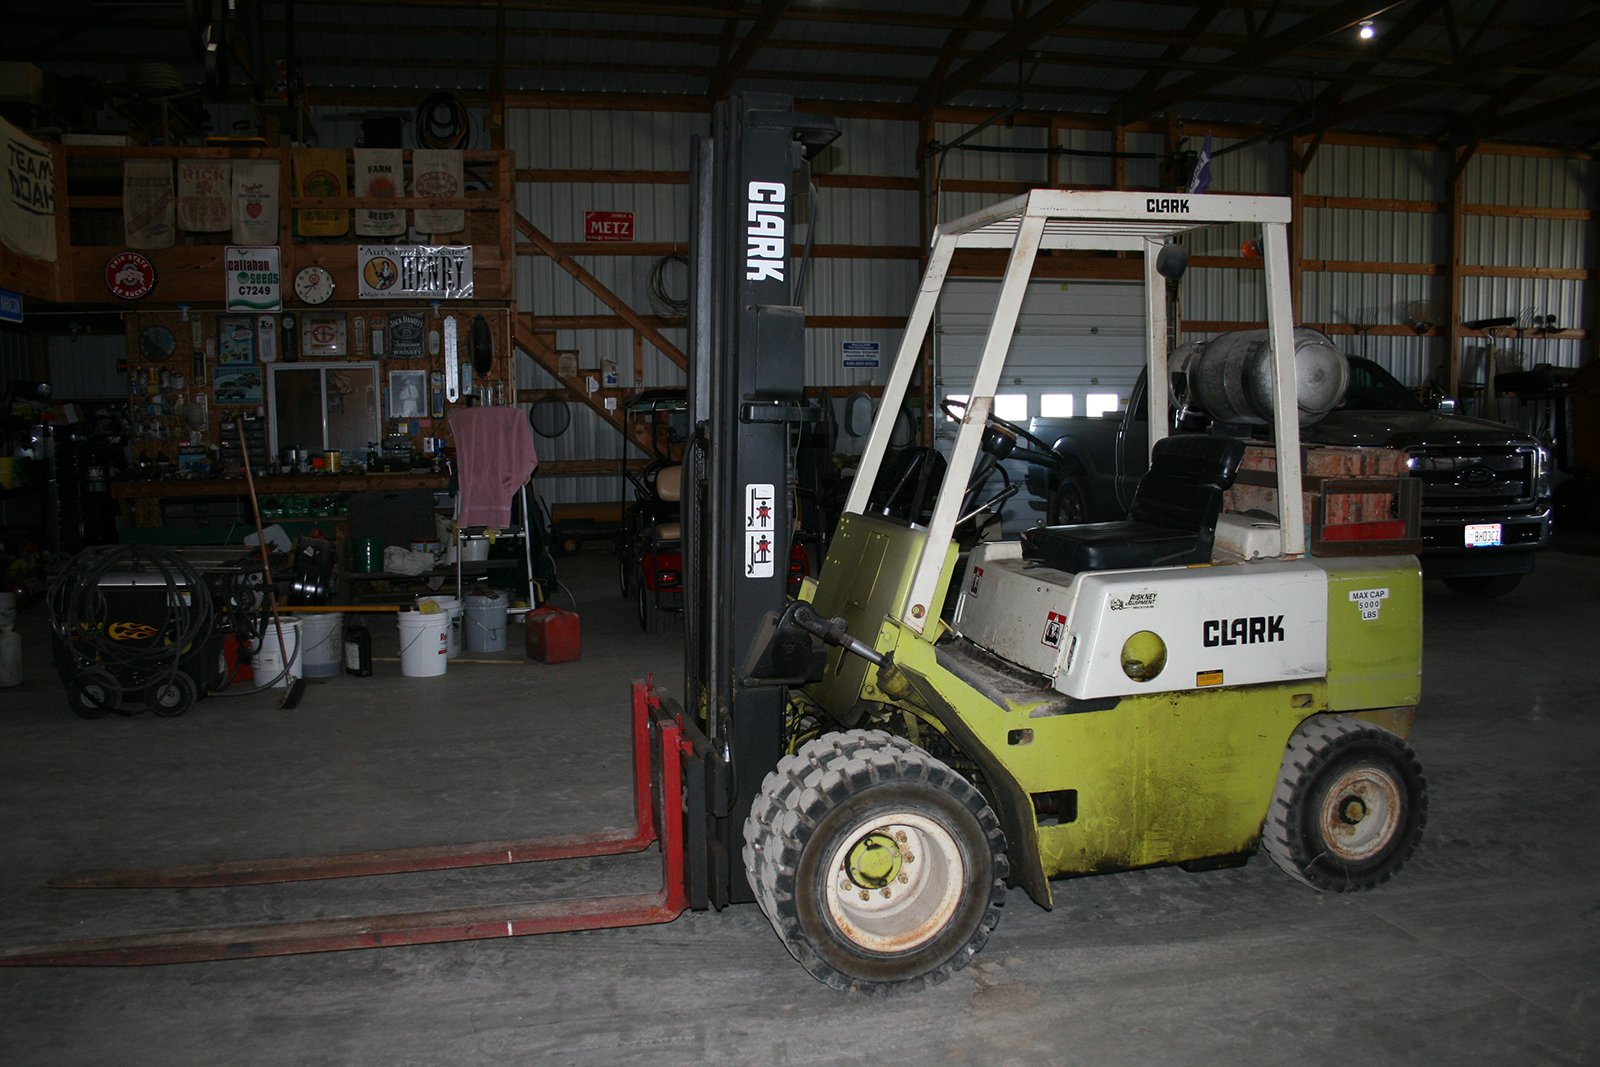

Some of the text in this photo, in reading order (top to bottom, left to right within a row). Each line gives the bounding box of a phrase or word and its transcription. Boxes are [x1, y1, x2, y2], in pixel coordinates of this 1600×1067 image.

[8, 143, 52, 179] TEAM
[182, 168, 225, 181] RICK
[367, 165, 392, 174] FARM
[1146, 199, 1190, 213] CLARK
[367, 211, 395, 220] SEEDS
[590, 221, 629, 234] METZ
[746, 181, 786, 282] CLARK
[110, 254, 148, 269] OHIO STATE
[228, 260, 269, 271] callahan
[250, 272, 279, 284] seeds
[400, 256, 465, 291] HENRY
[238, 286, 271, 295] C7249
[1352, 590, 1385, 600] MAX CAP
[1359, 600, 1380, 609] 5000
[1363, 611, 1377, 619] LBS
[1202, 615, 1285, 648] CLARK
